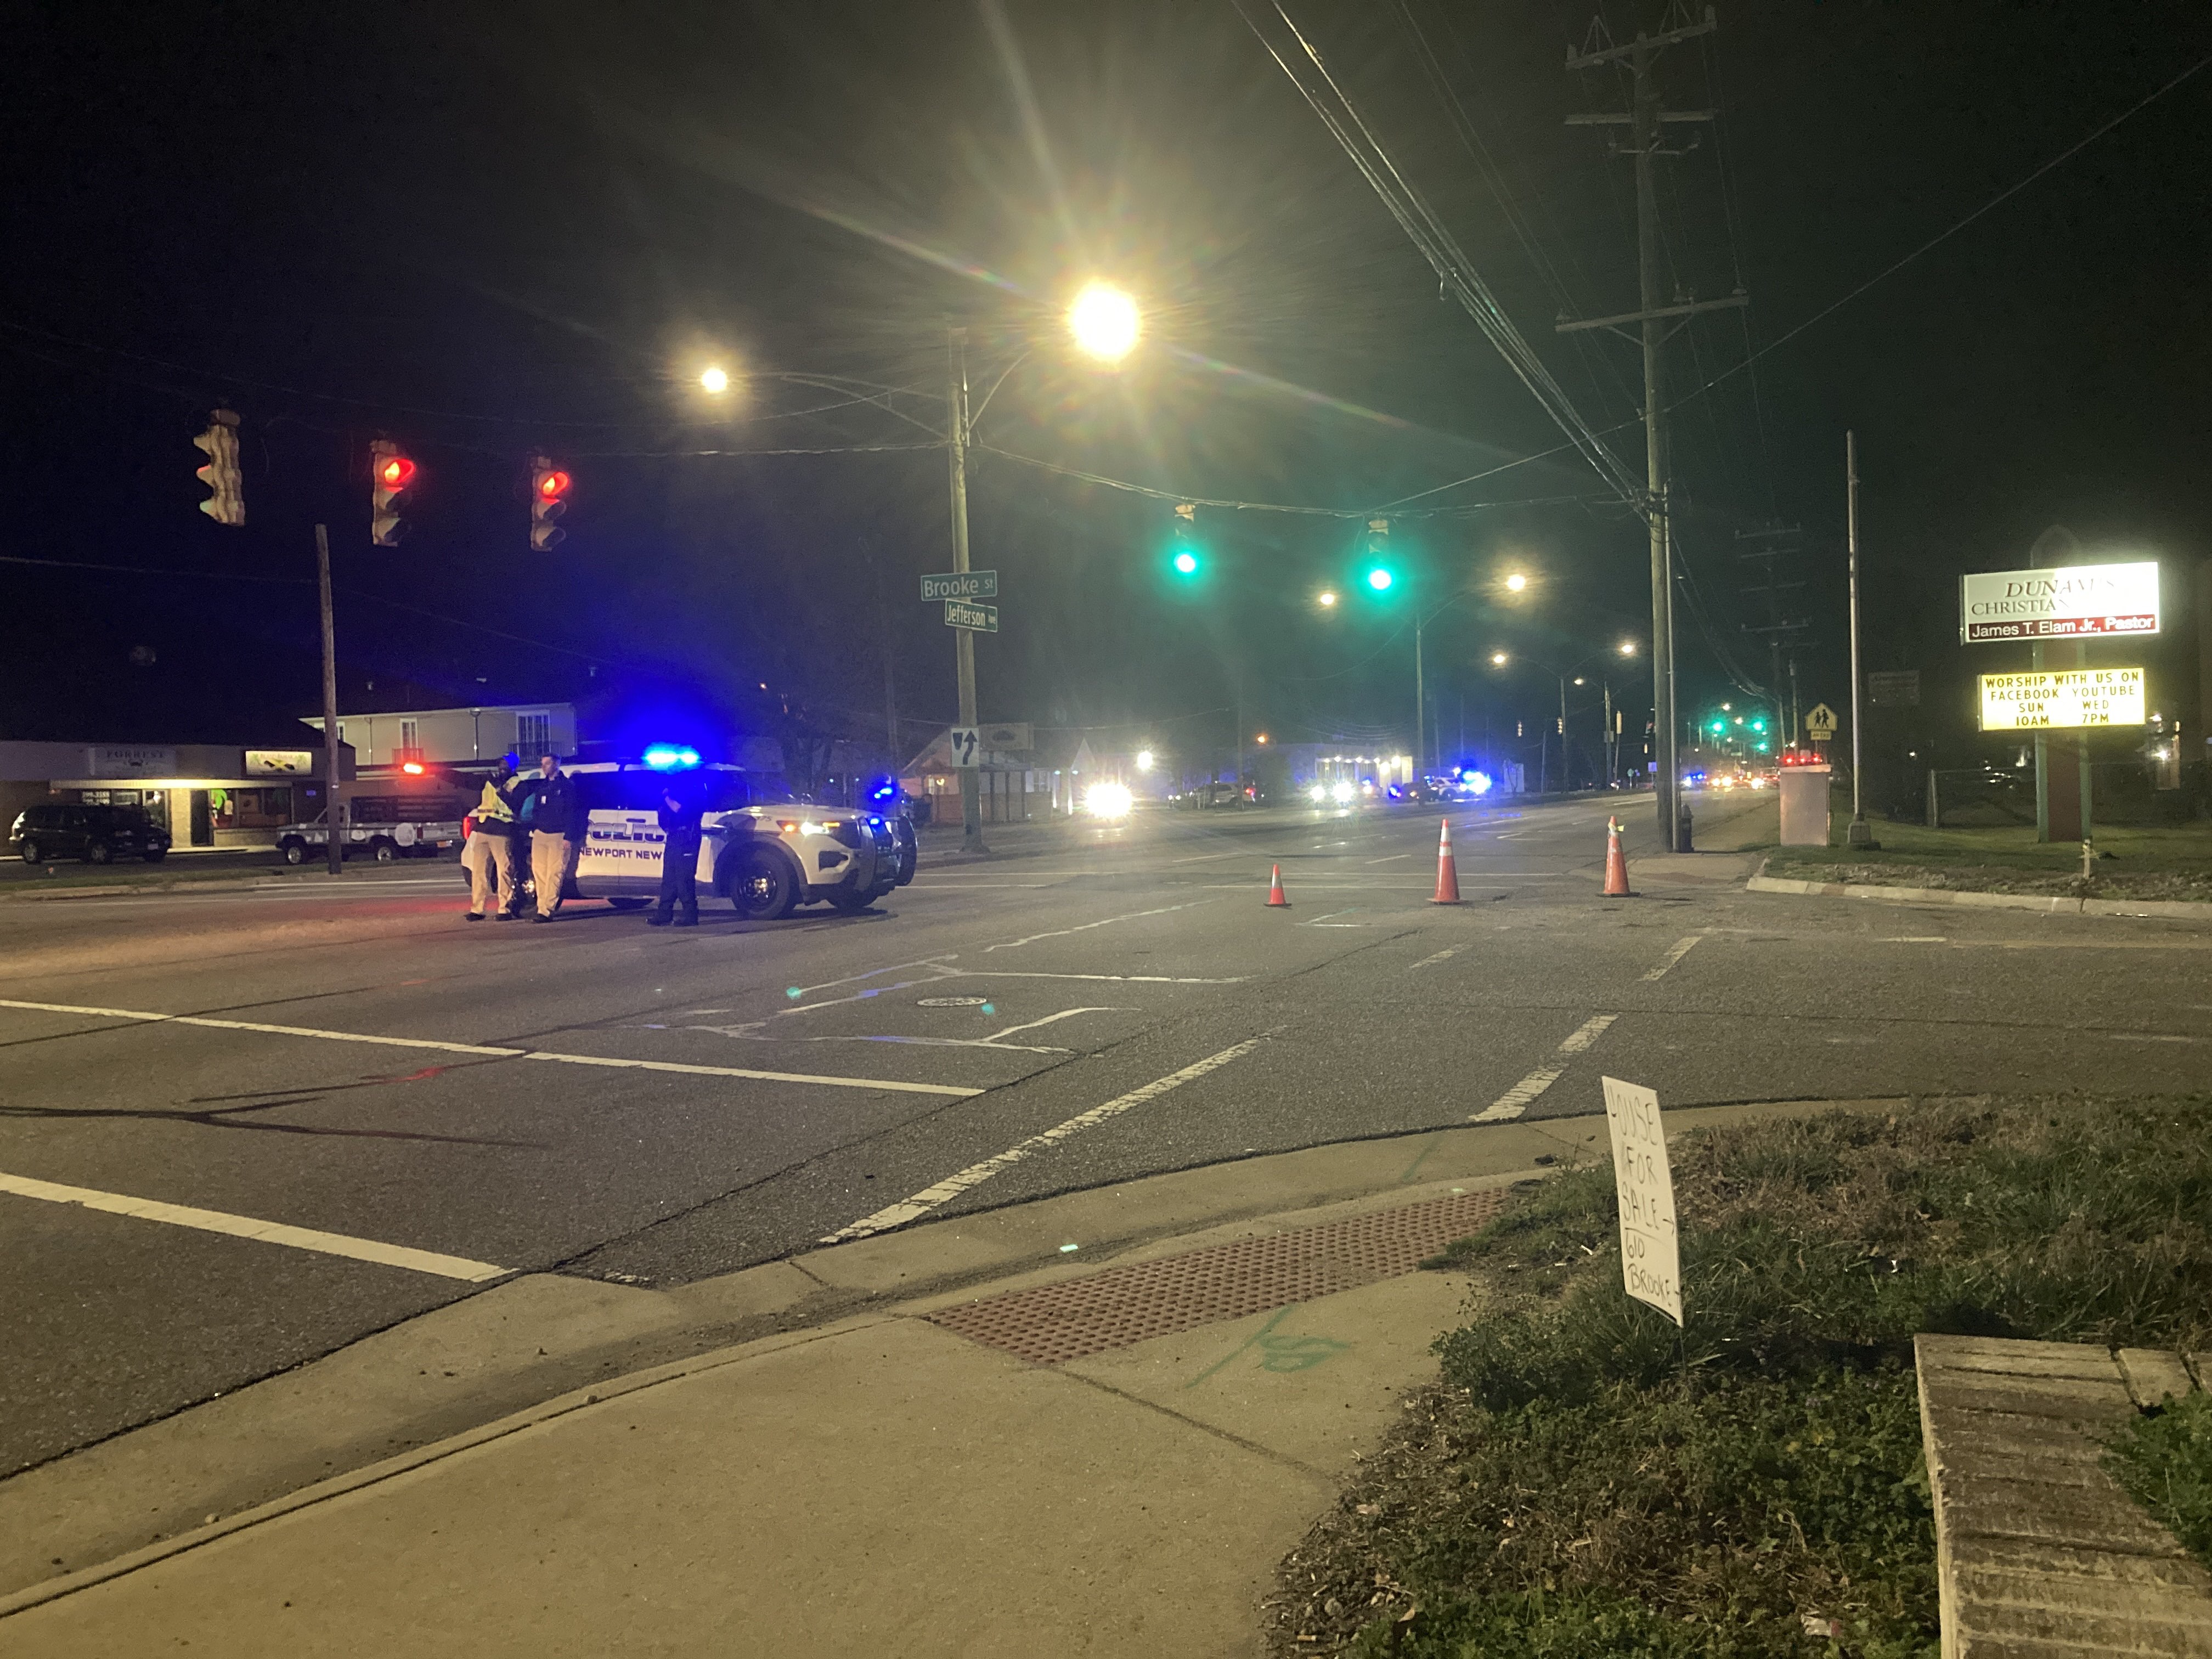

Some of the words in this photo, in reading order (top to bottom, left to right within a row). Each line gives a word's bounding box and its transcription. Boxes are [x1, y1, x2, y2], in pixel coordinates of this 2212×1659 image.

[924, 576, 979, 597] Brooke
[984, 578, 994, 589] St
[947, 605, 986, 627] Jefferson
[1972, 623, 2019, 638] James
[2023, 622, 2034, 635] T.
[2039, 620, 2076, 634] Elam
[2105, 614, 2154, 630] Pastor
[1985, 676, 2047, 689] WORSHIP
[2054, 674, 2087, 685] WITH
[2096, 673, 2113, 683] US
[2121, 672, 2139, 682] ON
[1990, 688, 2059, 701] FACEBOOK
[2072, 685, 2135, 697] YOUTUBE
[2019, 702, 2044, 713] SUN
[2082, 699, 2109, 710] WED
[2016, 715, 2049, 726] 10AM
[2082, 713, 2109, 723] 7PM
[580, 847, 633, 859] NEWPORT
[1627, 1146, 1658, 1186] FOR
[1622, 1181, 1660, 1231] SALE
[1626, 1231, 1645, 1259] 610
[1627, 1262, 1672, 1307] BROOKE
